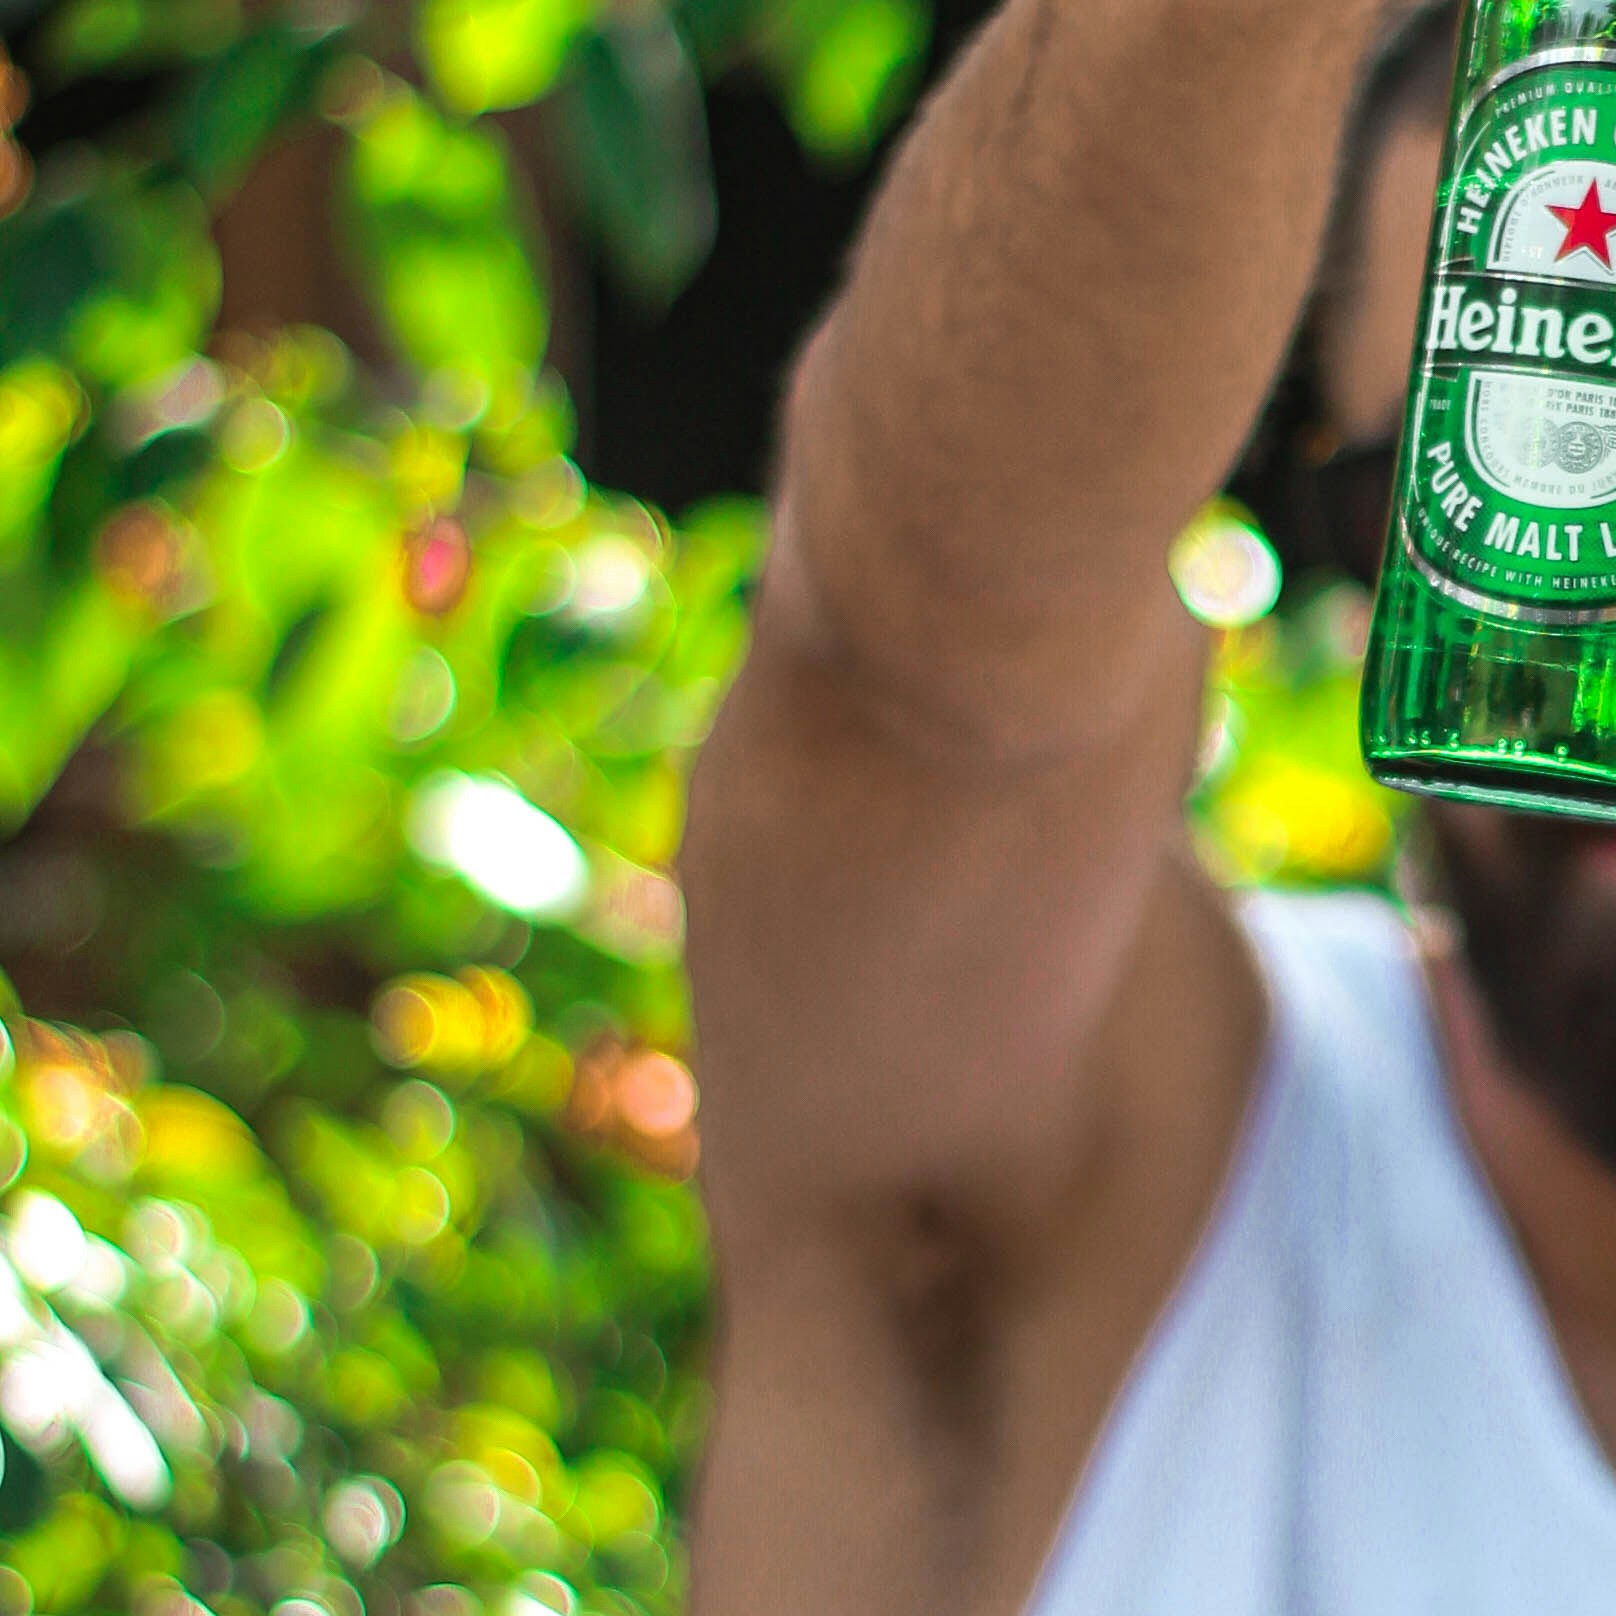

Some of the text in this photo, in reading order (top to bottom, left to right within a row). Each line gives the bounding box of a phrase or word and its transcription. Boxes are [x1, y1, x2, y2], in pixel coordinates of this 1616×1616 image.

[1457, 108, 1598, 235] HEINEKEN
[1565, 402, 1595, 417] PARIS
[1575, 391, 1604, 406] PARIS
[1427, 440, 1484, 532] PURE
[1483, 511, 1584, 562] MALT
[1451, 548, 1498, 578] RECIPE
[1505, 569, 1544, 587] WITH
